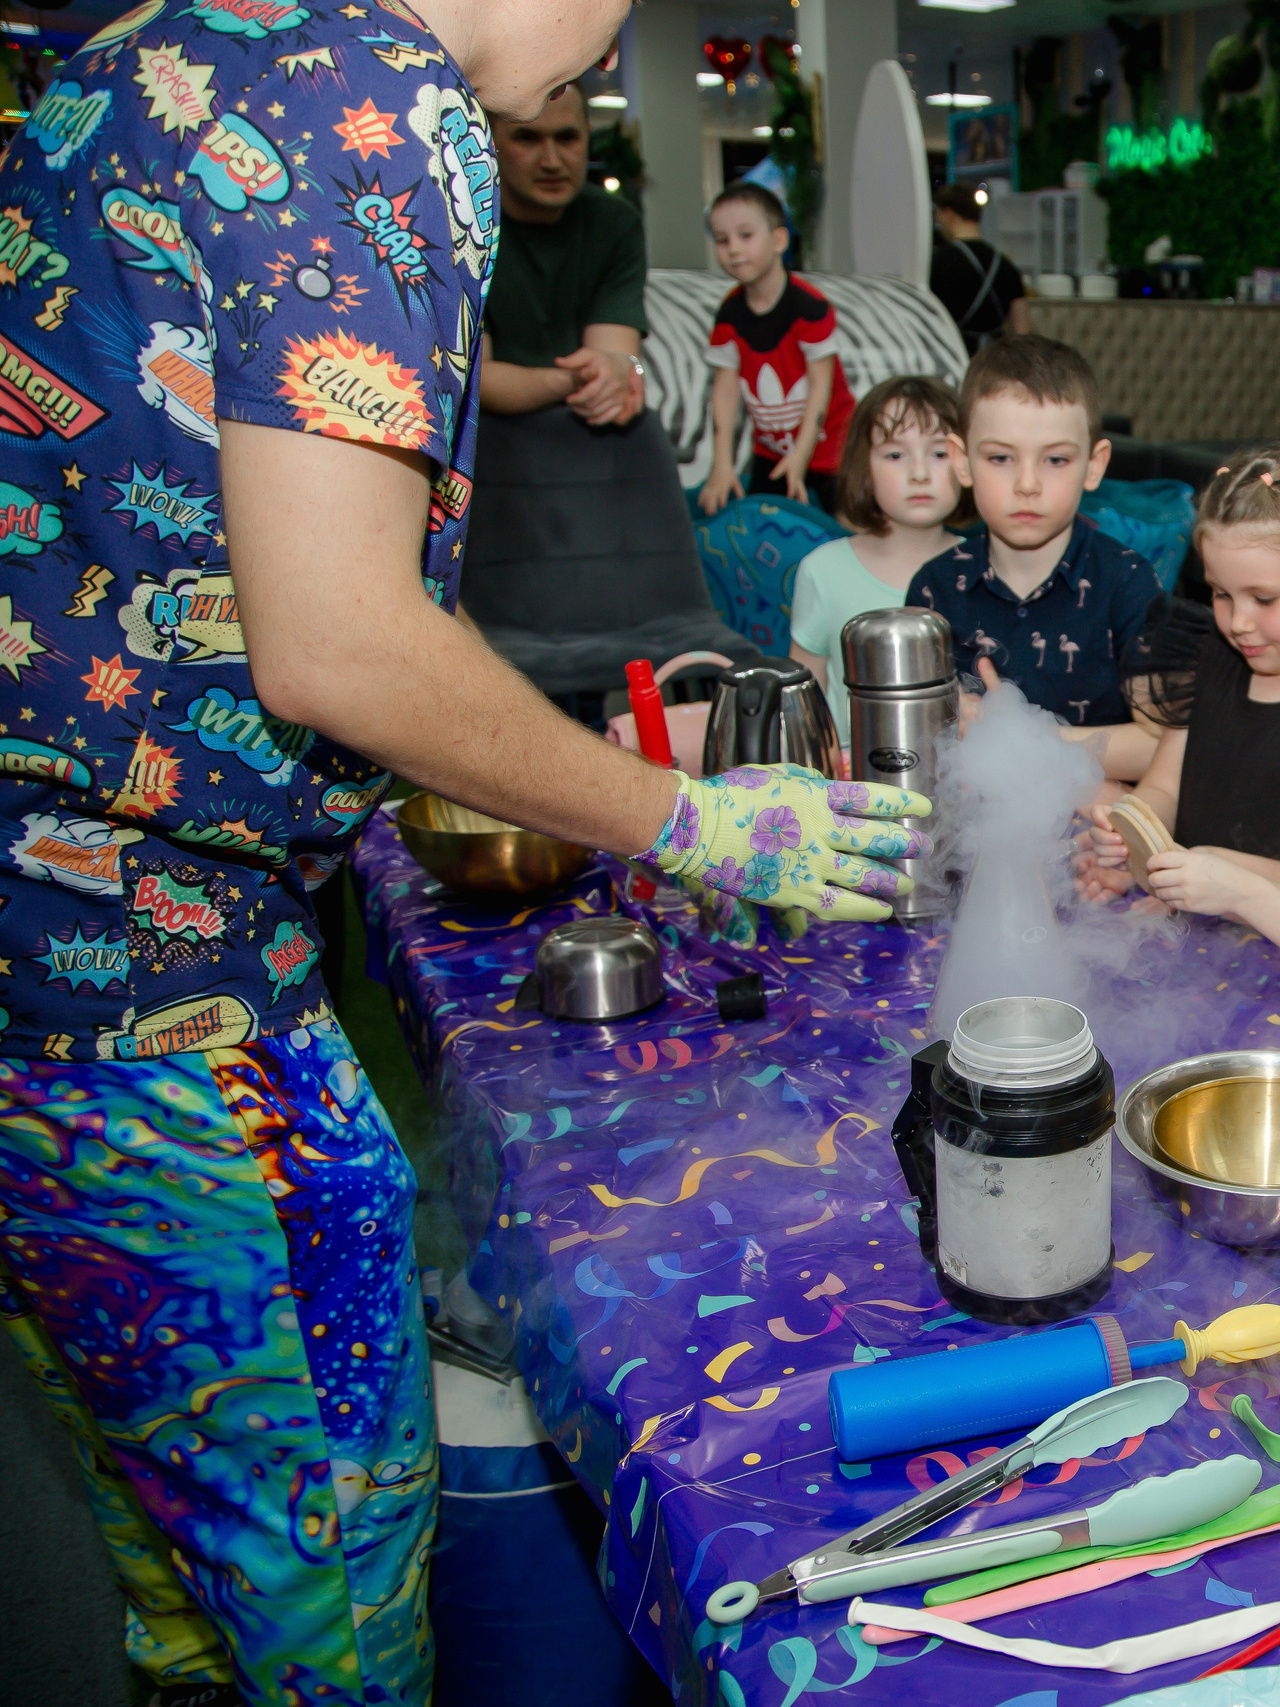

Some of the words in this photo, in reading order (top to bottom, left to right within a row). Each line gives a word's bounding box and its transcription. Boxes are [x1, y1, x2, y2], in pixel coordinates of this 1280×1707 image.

[354, 194, 428, 279] CHAP!
[148, 349, 215, 426] WHAC
[303, 355, 425, 442] BANG!!!
[130, 484, 203, 529] WOW!
[53, 948, 129, 972] WOW!
[155, 1001, 221, 1056] YEAH!
